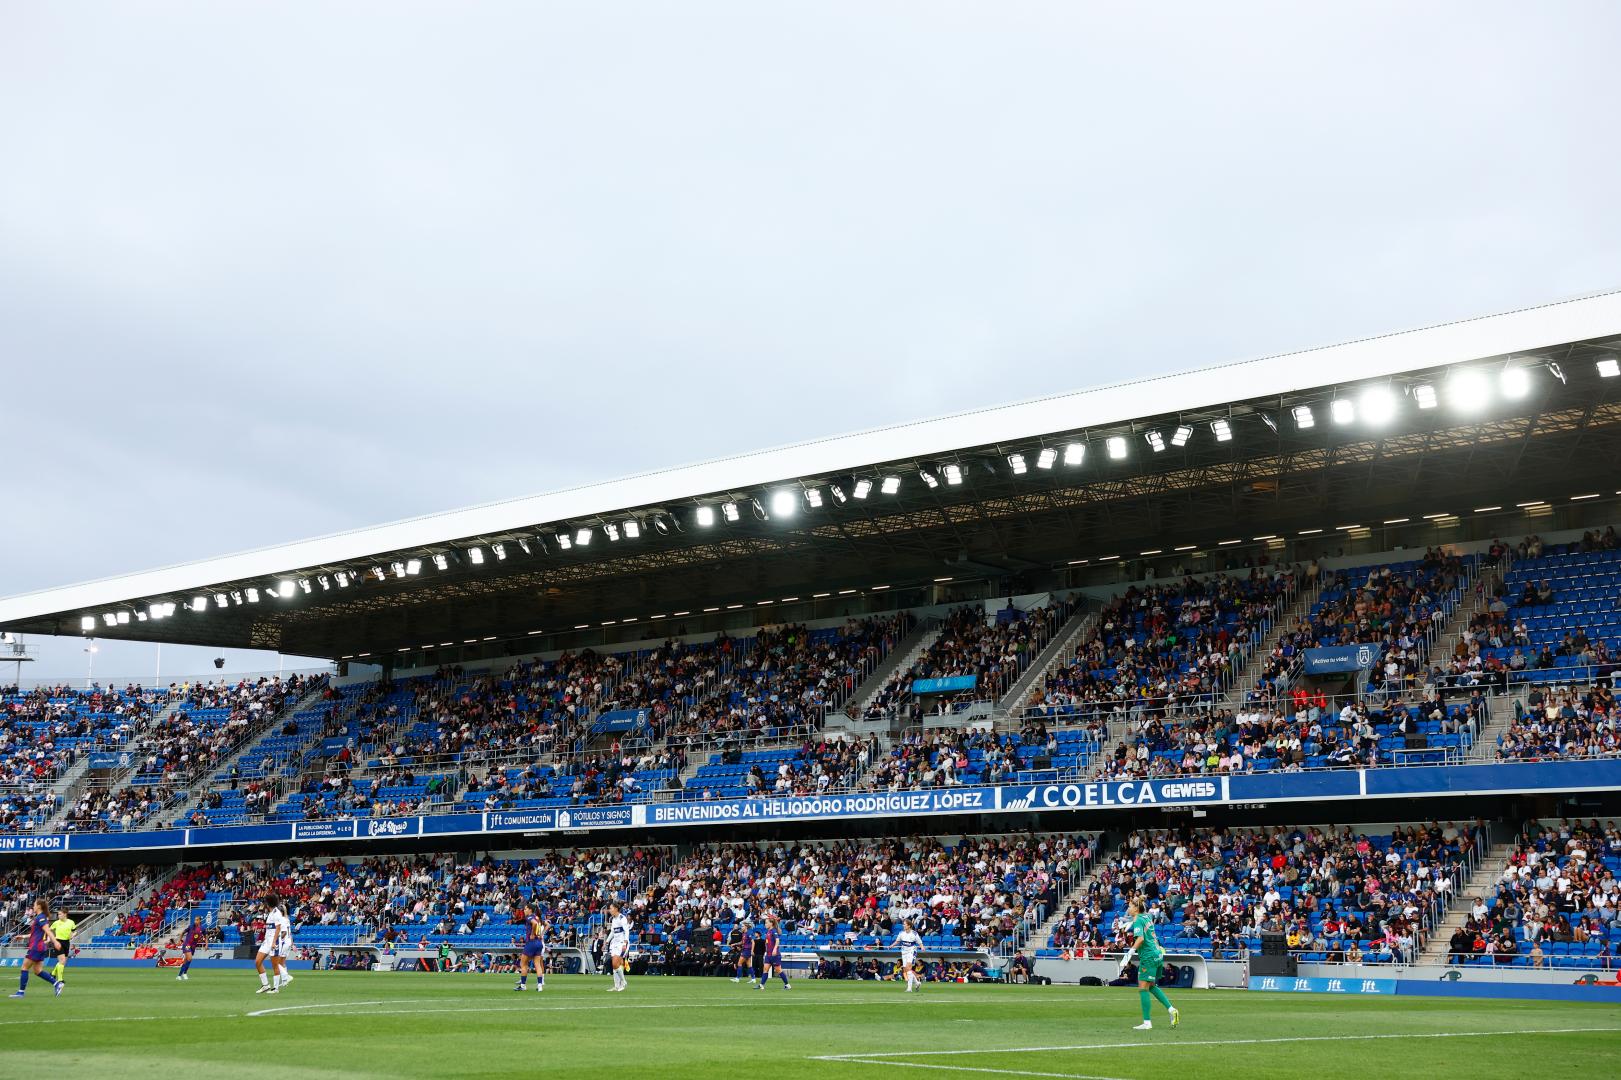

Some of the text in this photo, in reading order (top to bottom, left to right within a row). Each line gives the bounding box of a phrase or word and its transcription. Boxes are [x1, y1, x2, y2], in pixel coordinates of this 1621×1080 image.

[1043, 782, 1157, 807] COELCA
[655, 791, 982, 821] BIENVENIDOS AL HELIODORO RODRÍGUEZ LÓPEZ
[490, 814, 552, 829] jft COMUNICACIÓN
[573, 810, 631, 821] RÓTULOS Y SIGNOS
[0, 838, 60, 849] IN TEMOR
[1261, 978, 1275, 990] jft
[1293, 979, 1308, 991] jft
[1326, 980, 1342, 992] jft
[1360, 980, 1376, 993] jft
